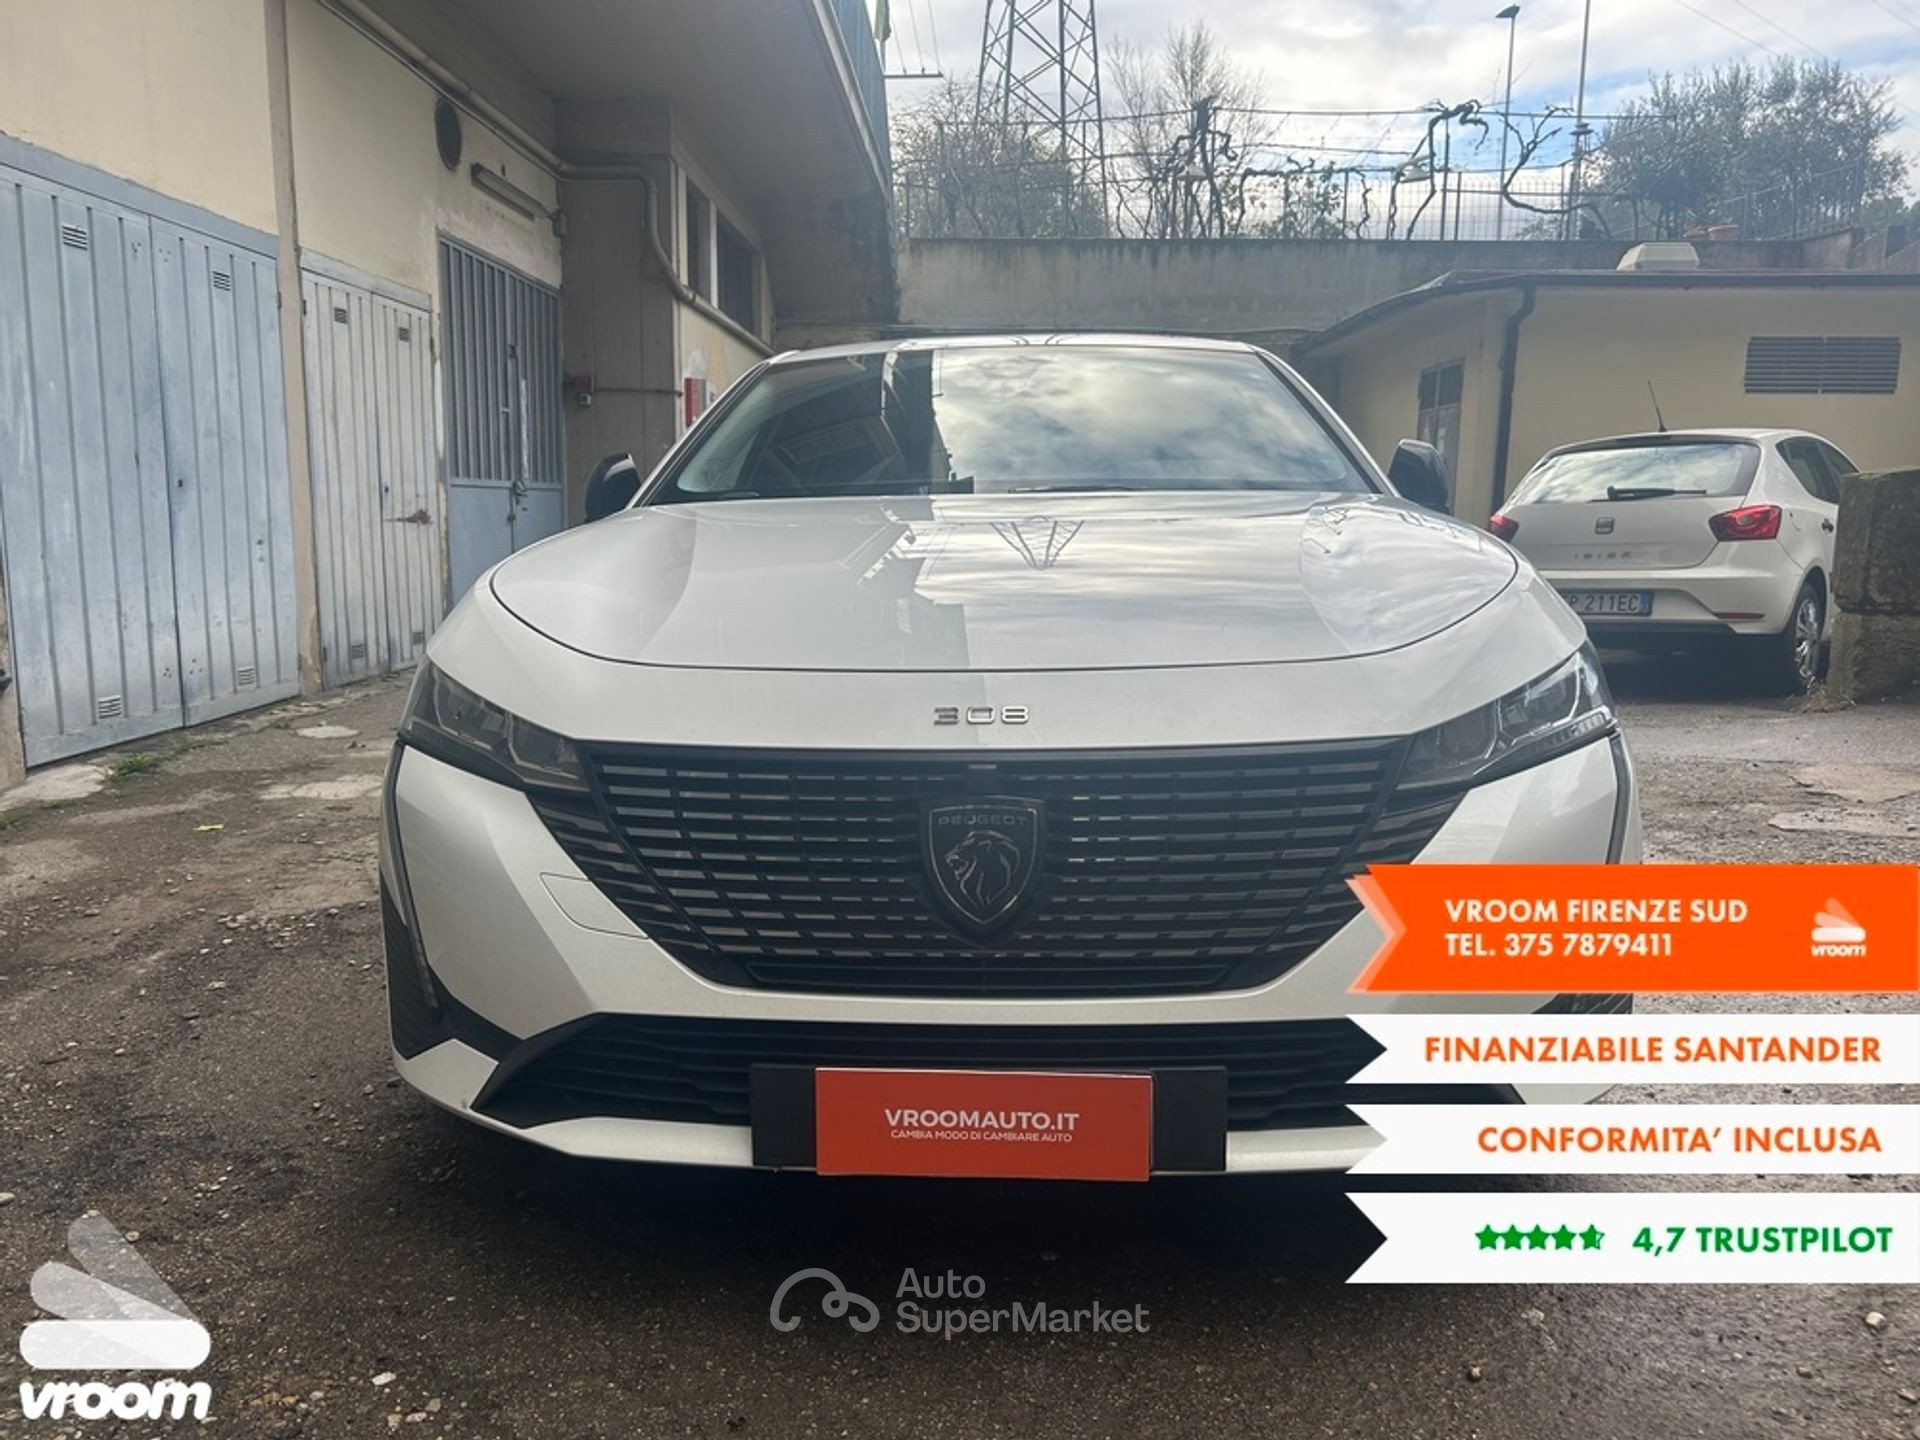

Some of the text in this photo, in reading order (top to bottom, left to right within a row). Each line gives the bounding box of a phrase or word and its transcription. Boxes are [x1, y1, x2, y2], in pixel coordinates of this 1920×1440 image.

[933, 706, 1030, 726] 308
[938, 814, 1028, 826] PEUGEOT
[884, 1109, 1080, 1131] VROOMAUTO.IT
[891, 1129, 1073, 1143] CAMBIA MODO DI CAMBIARE AUTO
